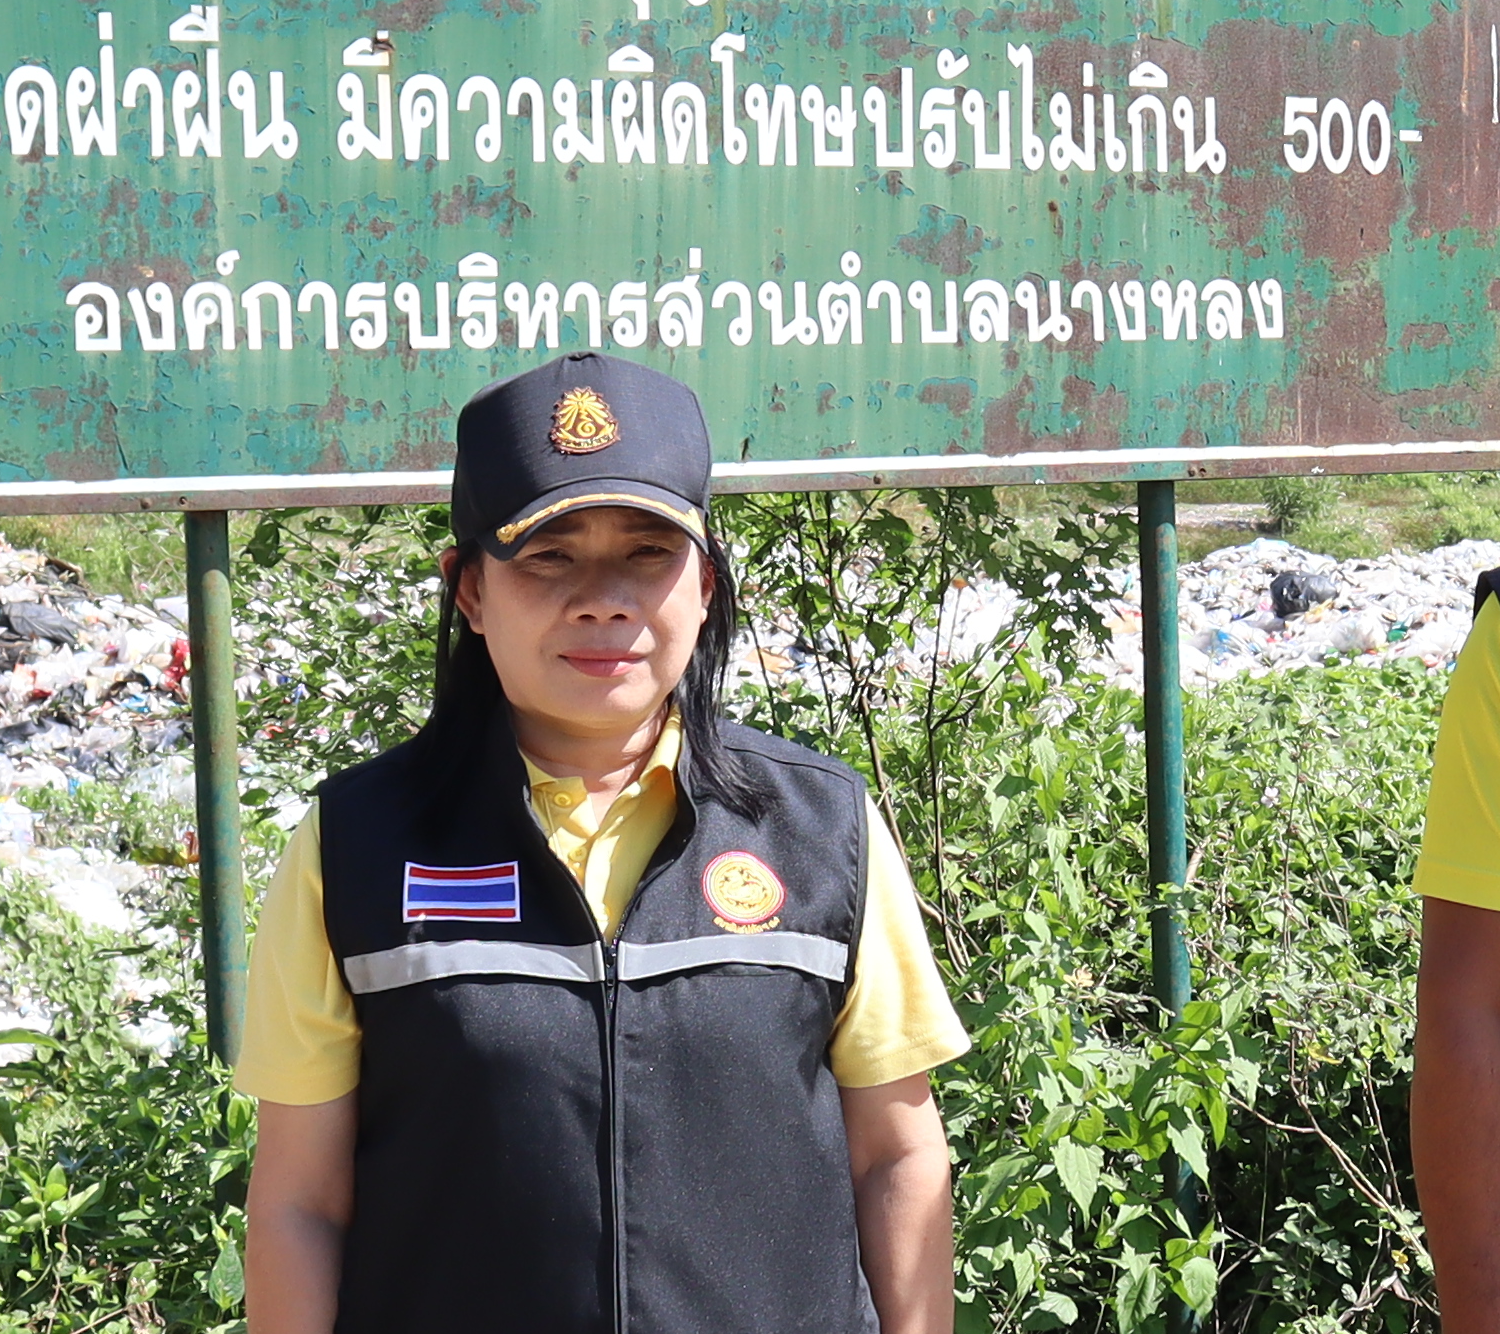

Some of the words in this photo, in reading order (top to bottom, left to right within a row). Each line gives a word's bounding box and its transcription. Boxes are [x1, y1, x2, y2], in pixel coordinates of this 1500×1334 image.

[337, 32, 1226, 175] มีความผิดโทษปรับไม่เกิน
[65, 247, 1284, 351] องค์การบริหารส่วนตำบลนางหลง
